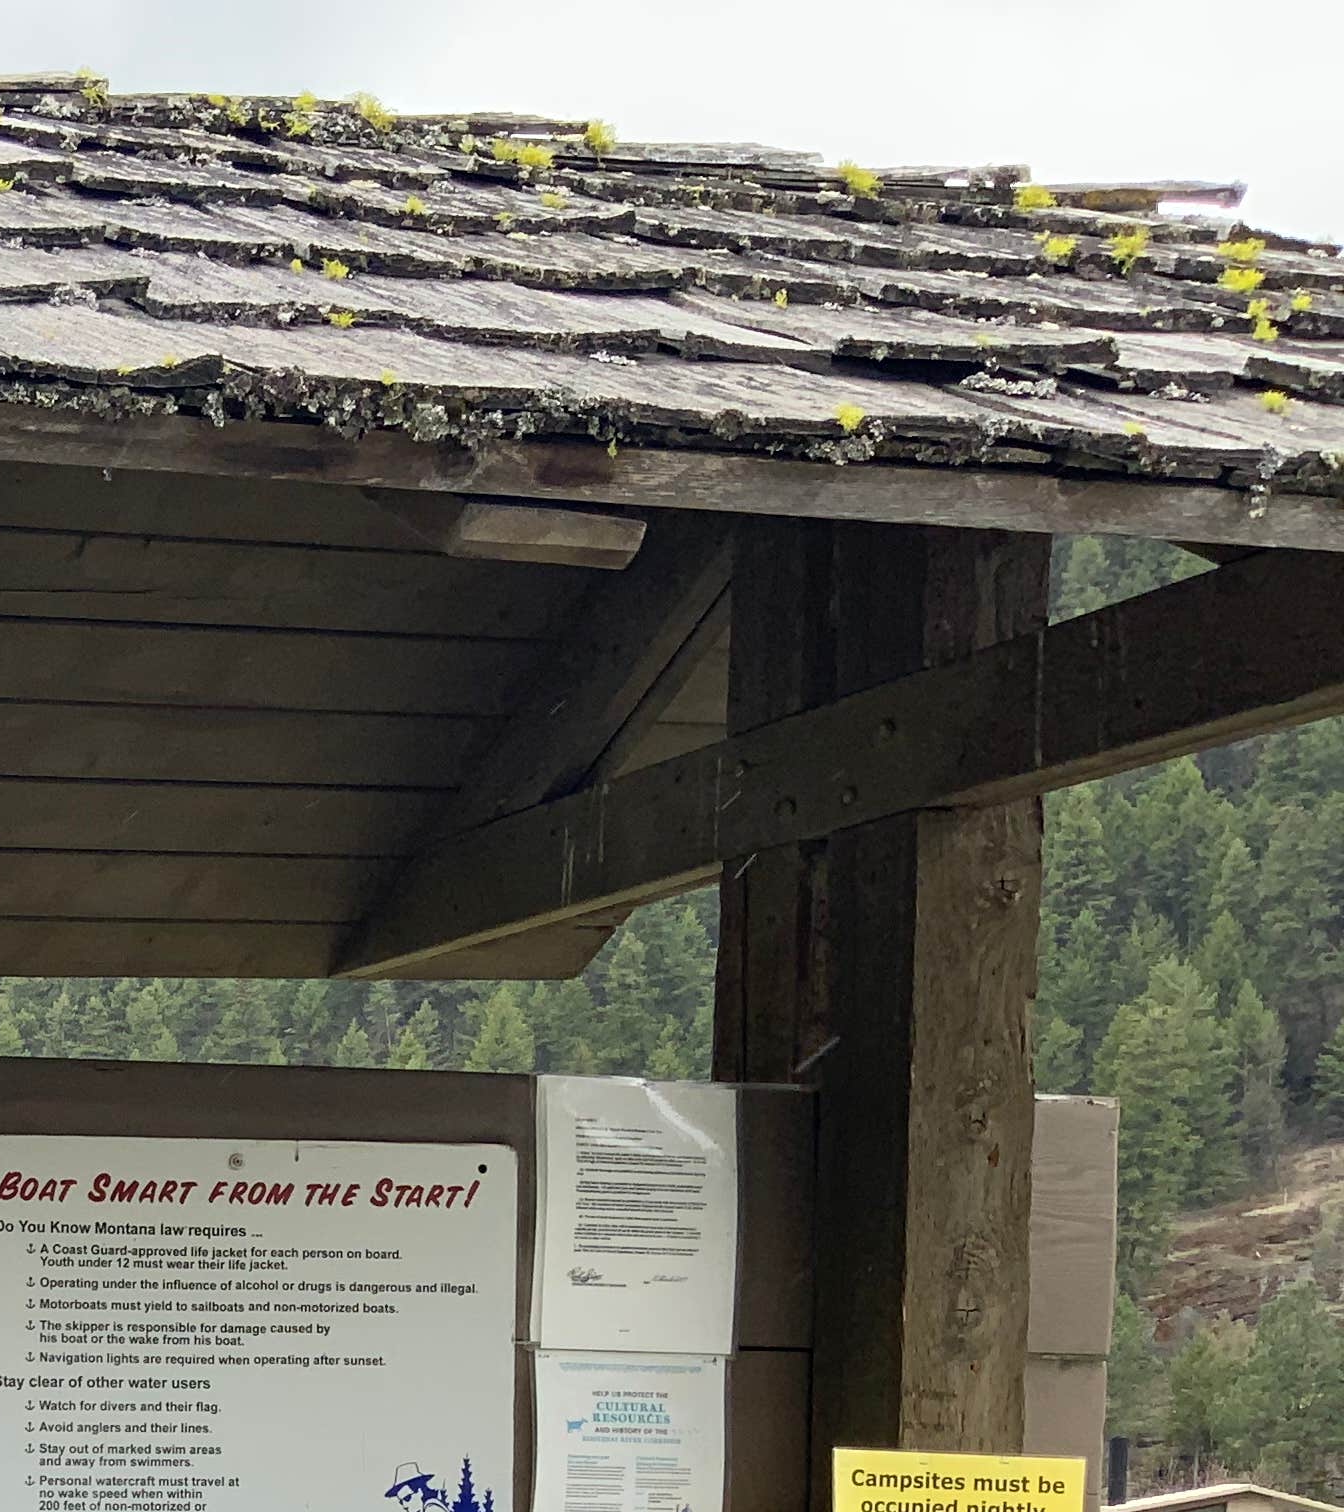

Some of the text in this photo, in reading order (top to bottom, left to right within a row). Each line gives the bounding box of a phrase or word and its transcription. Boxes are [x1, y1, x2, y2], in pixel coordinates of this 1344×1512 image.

[18, 1219, 45, 1233] You
[50, 1220, 91, 1234] Know
[94, 1221, 155, 1235] Montana
[160, 1223, 184, 1236] law
[188, 1224, 246, 1239] requires
[28, 1375, 64, 1387] clear
[68, 1375, 83, 1388] of
[86, 1376, 124, 1388] other
[128, 1377, 167, 1389] water
[171, 1379, 211, 1389] users
[596, 1401, 665, 1412] CULTURAL
[592, 1412, 671, 1424] RESOURCES
[851, 1469, 1064, 1494] Campsites must be
